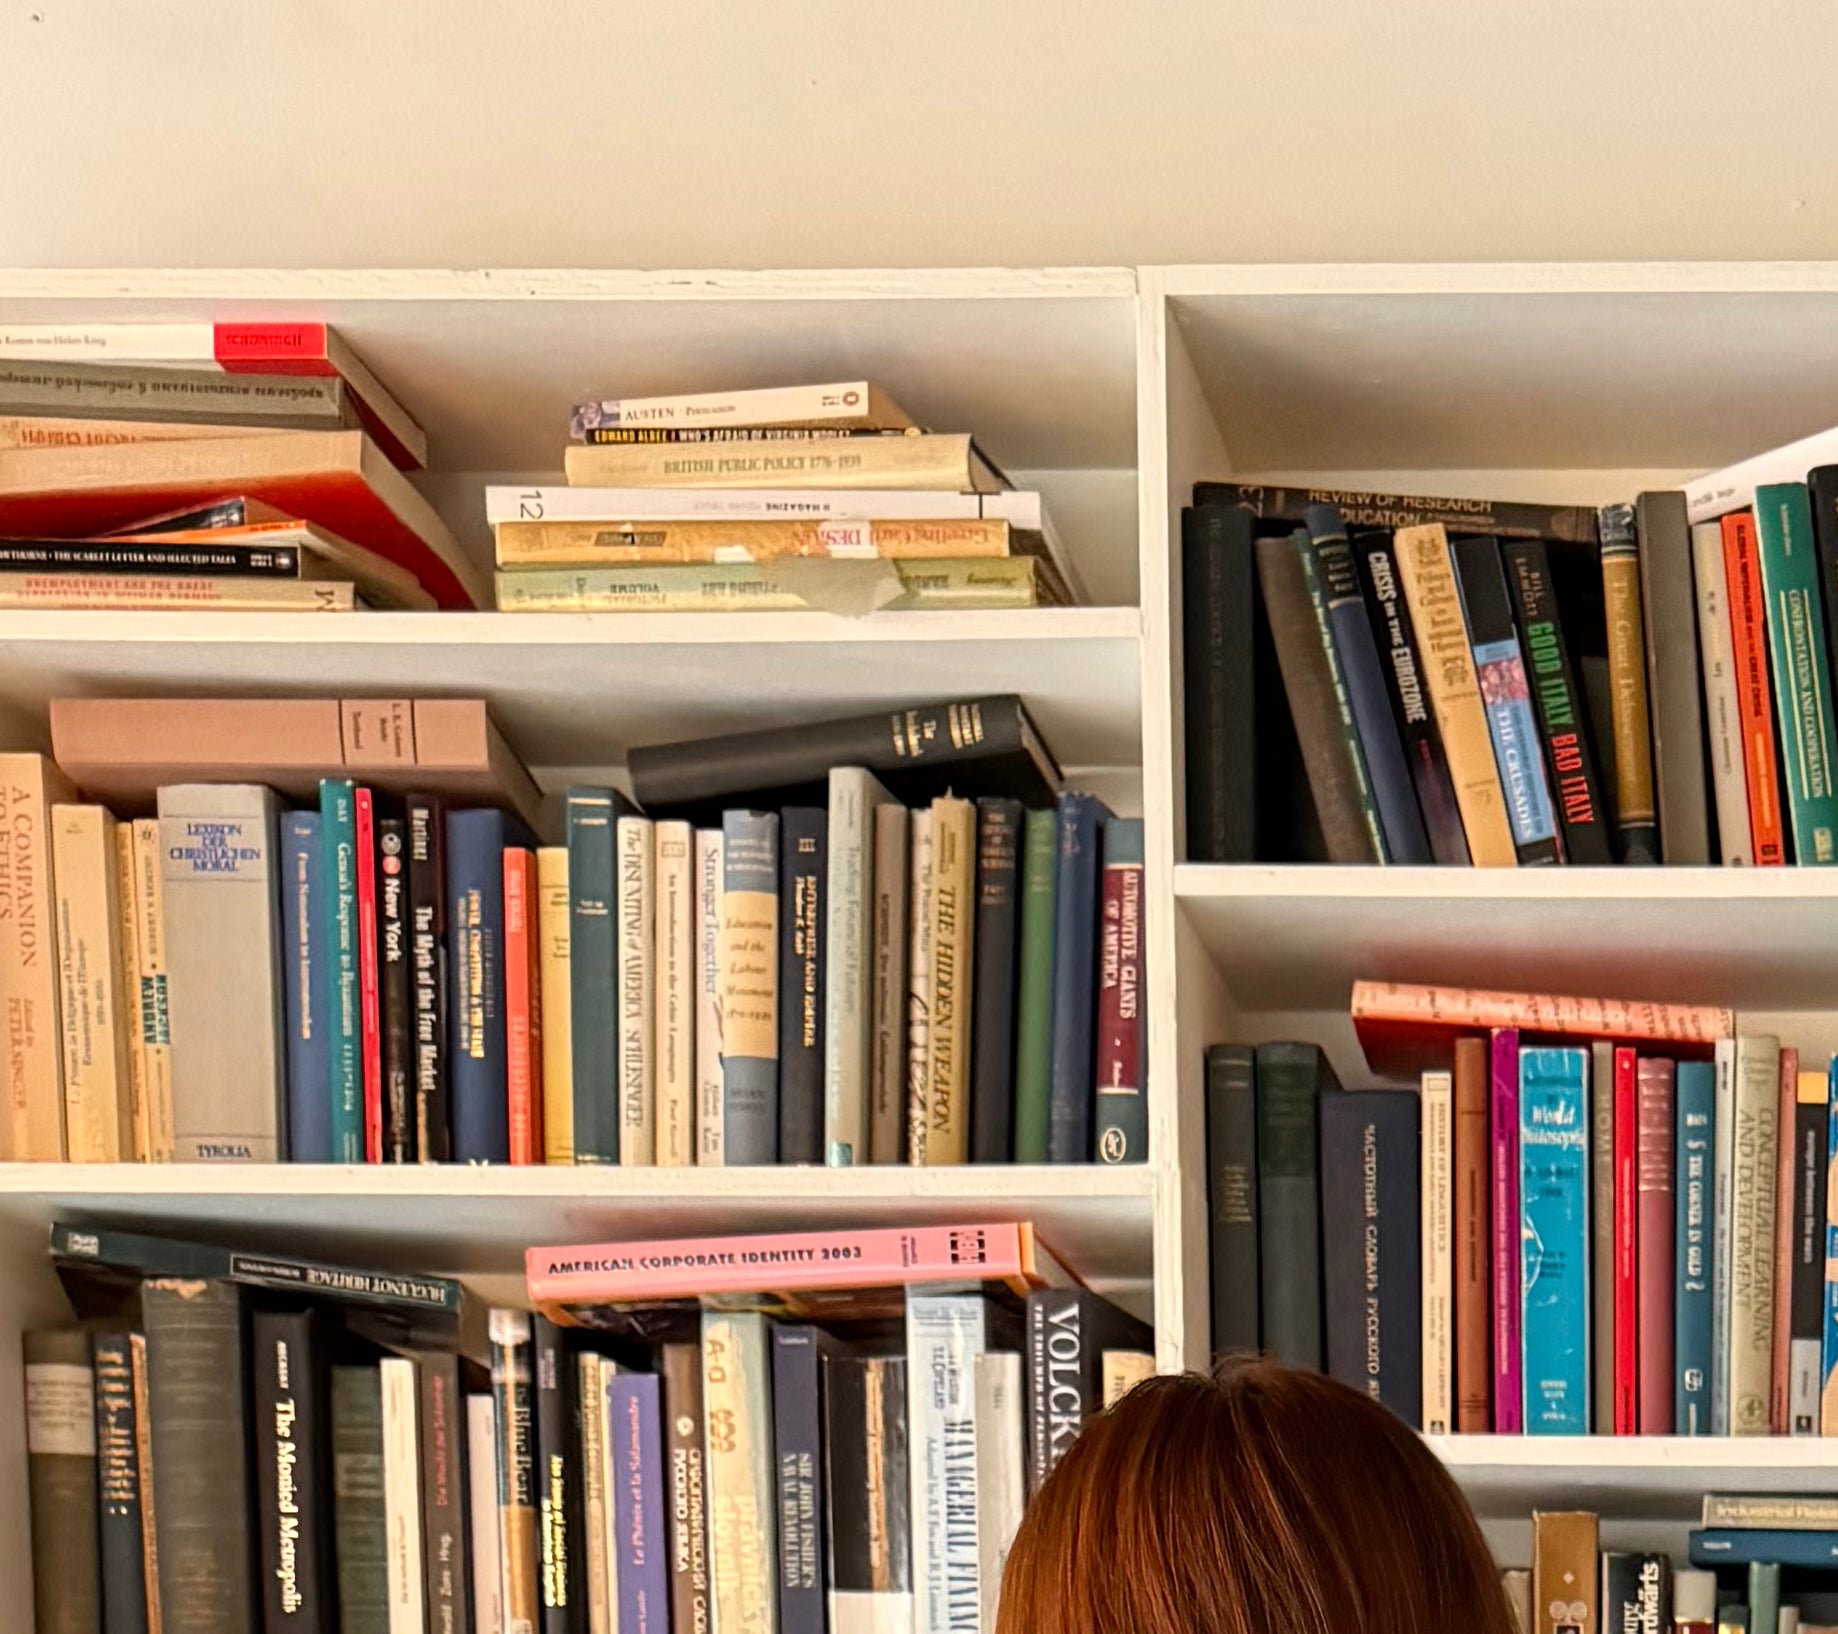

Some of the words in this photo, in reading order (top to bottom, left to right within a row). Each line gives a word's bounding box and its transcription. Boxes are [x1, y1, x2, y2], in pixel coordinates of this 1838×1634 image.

[664, 458, 714, 475] BRITISH
[717, 457, 761, 473] PUBLIC
[763, 456, 805, 472] POLICY
[519, 489, 543, 520] 12
[1308, 488, 1372, 507] REVIEW
[1375, 492, 1403, 509] OF
[1405, 494, 1493, 514] RESEARCH
[609, 583, 659, 594] VOLUME
[1367, 551, 1396, 601] CRISIS
[1382, 601, 1397, 615] IN
[1386, 616, 1404, 647] THE
[1526, 620, 1563, 672] GOOD
[1392, 647, 1427, 724] EUROZONE
[1495, 706, 1515, 746] THE
[1505, 749, 1533, 840] CRUSADES
[1550, 732, 1583, 773] BAD
[11, 785, 32, 803] A
[1559, 776, 1594, 825] ITALY
[169, 847, 261, 860] CHRISTLICHEN
[192, 860, 239, 872] MORAL
[13, 813, 37, 967] COMPANION
[385, 878, 401, 919] New
[701, 847, 719, 918] Stronger
[415, 907, 434, 931] The
[937, 886, 956, 934] THE
[1104, 899, 1119, 920] OF
[1121, 871, 1139, 960] AUTOMOTIVE
[385, 921, 402, 962] York
[412, 934, 435, 967] Myth
[701, 921, 720, 994] Together
[1102, 923, 1119, 989] AMERICA
[417, 971, 435, 985] of
[418, 988, 435, 1009] the
[934, 943, 955, 1026] HIDDEN
[1119, 965, 1138, 1019] GIANTS
[141, 974, 157, 1044] ANDREW
[156, 974, 170, 1046] JACKSON
[418, 1012, 436, 1041] Free
[419, 1044, 437, 1090] Market
[933, 1034, 951, 1136] WEAPON
[1363, 1124, 1378, 1218] ЧАСТОТНЫЙ
[1689, 1155, 1702, 1178] THE
[1755, 1106, 1775, 1248] CONCEPTUAL
[1688, 1181, 1702, 1226] CORNER
[1688, 1229, 1701, 1242] IN
[547, 1257, 635, 1277] AMERICAN
[639, 1251, 736, 1272] CORPORATE
[741, 1248, 815, 1264] IDENTITY
[820, 1245, 863, 1261] 2003
[1364, 1225, 1378, 1291] СЛОВАРЬ
[1688, 1246, 1702, 1277] GOLD
[1752, 1251, 1772, 1351] LEARNING
[1365, 1298, 1379, 1374] РУССКОГО
[275, 1398, 295, 1438] The
[628, 1396, 642, 1470] Salamandre
[276, 1440, 298, 1513] Monied
[629, 1472, 642, 1486] la
[798, 1453, 813, 1478] SIR
[944, 1418, 977, 1553] MANAGERIAL
[631, 1488, 642, 1500] et
[798, 1481, 813, 1519] JOHN
[274, 1516, 302, 1613] Metropolis
[633, 1548, 646, 1565] Le
[800, 1522, 815, 1588] FISHER'S
